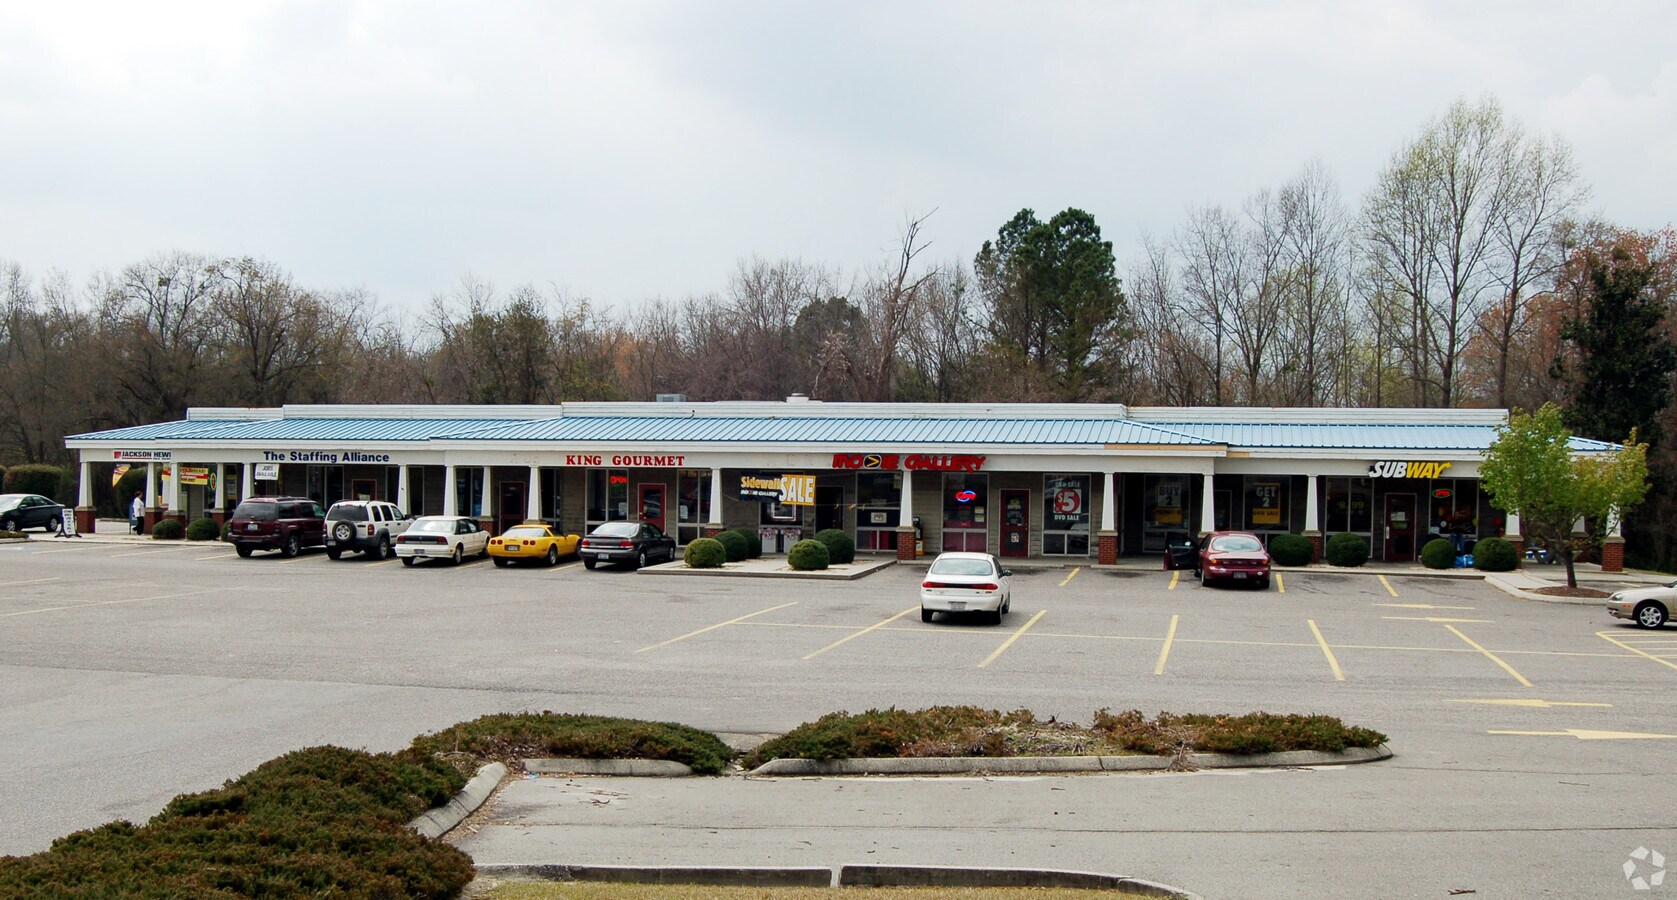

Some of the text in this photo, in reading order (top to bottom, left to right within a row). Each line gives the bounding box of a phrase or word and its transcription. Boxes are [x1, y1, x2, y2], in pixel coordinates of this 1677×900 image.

[263, 451, 390, 463] The Staffing Alliance
[566, 455, 685, 466] KING GOURMET
[904, 454, 987, 474] GALLERY
[1368, 461, 1452, 479] SUBWAY
[779, 476, 814, 503] SALE
[1159, 486, 1180, 496] BUY
[1256, 486, 1276, 497] GET
[1166, 496, 1173, 506] 2
[1262, 497, 1270, 508] 2
